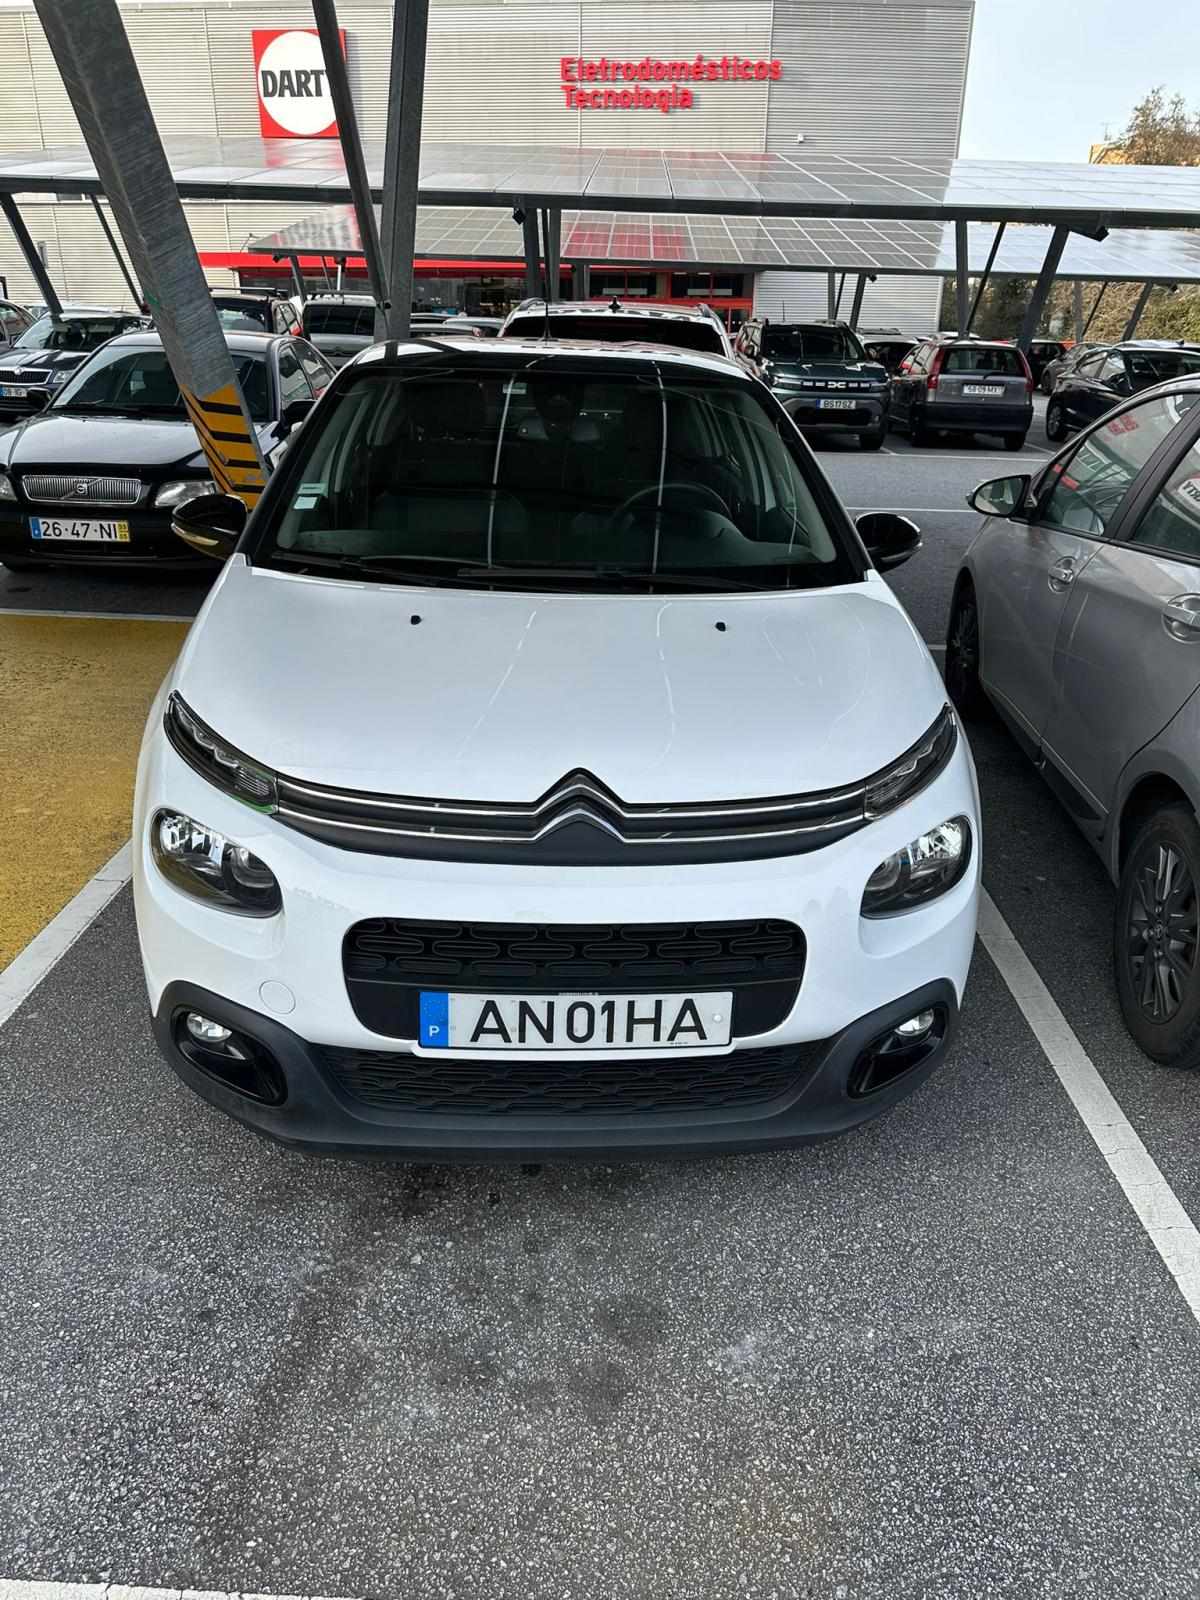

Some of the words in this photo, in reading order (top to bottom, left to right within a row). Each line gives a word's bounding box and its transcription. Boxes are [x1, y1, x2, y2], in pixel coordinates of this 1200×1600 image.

[560, 54, 782, 81] Eletrodomésticos
[261, 69, 326, 98] DART
[560, 84, 694, 113] Tecnologia
[429, 1025, 440, 1037] P
